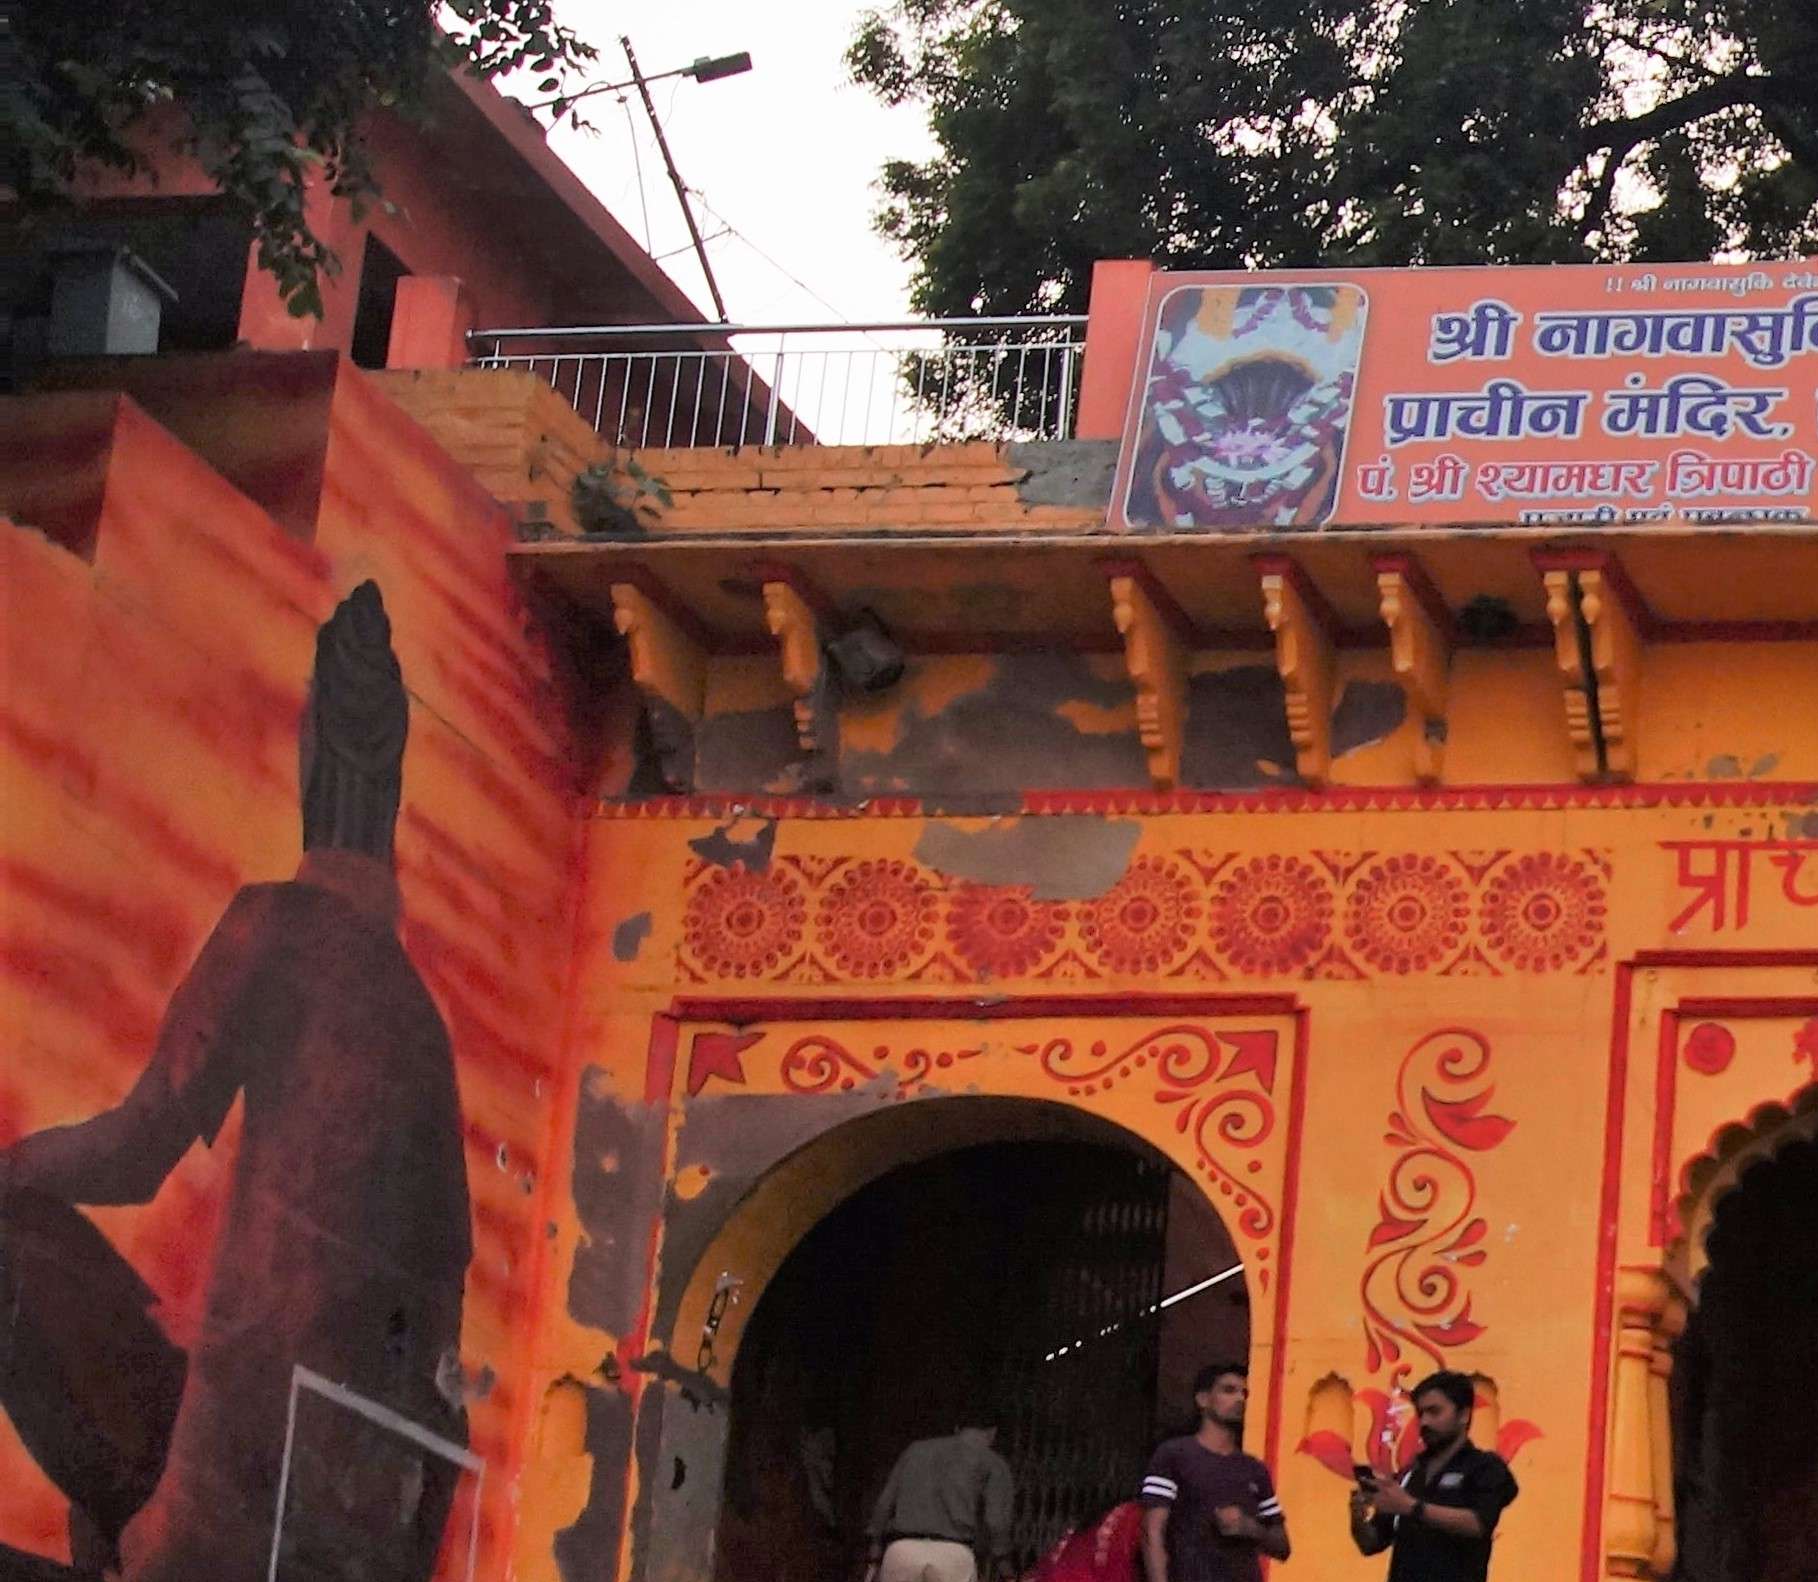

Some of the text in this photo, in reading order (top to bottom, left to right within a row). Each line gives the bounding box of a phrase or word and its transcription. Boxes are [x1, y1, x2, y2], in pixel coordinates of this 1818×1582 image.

[1430, 300, 1521, 361] श्री
[1385, 380, 1590, 442] प्राचीन
[1357, 455, 1397, 497] पं.
[1408, 454, 1470, 500] श्री
[1666, 450, 1813, 495] त्रिपाठी
